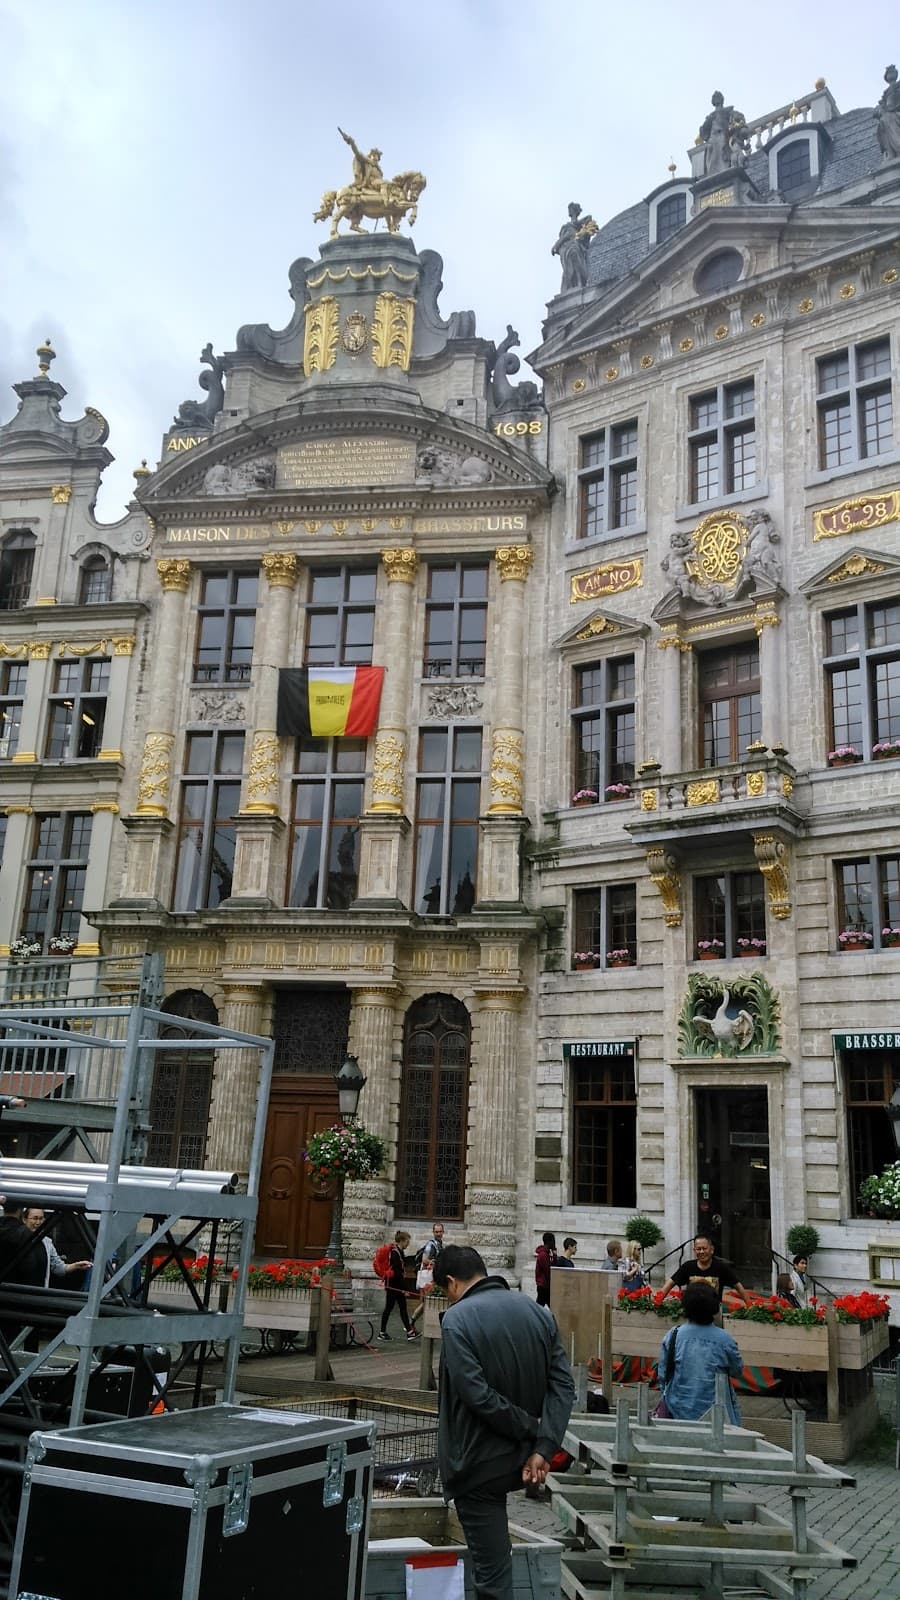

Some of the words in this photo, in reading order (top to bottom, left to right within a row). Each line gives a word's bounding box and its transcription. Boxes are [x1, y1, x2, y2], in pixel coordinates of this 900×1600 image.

[494, 421, 542, 437] 1698
[167, 437, 208, 451] ANN
[170, 527, 230, 542] MAISON
[236, 527, 271, 540] DES
[415, 516, 524, 533] BRASSEURS
[571, 1044, 624, 1057] RESTAURANT
